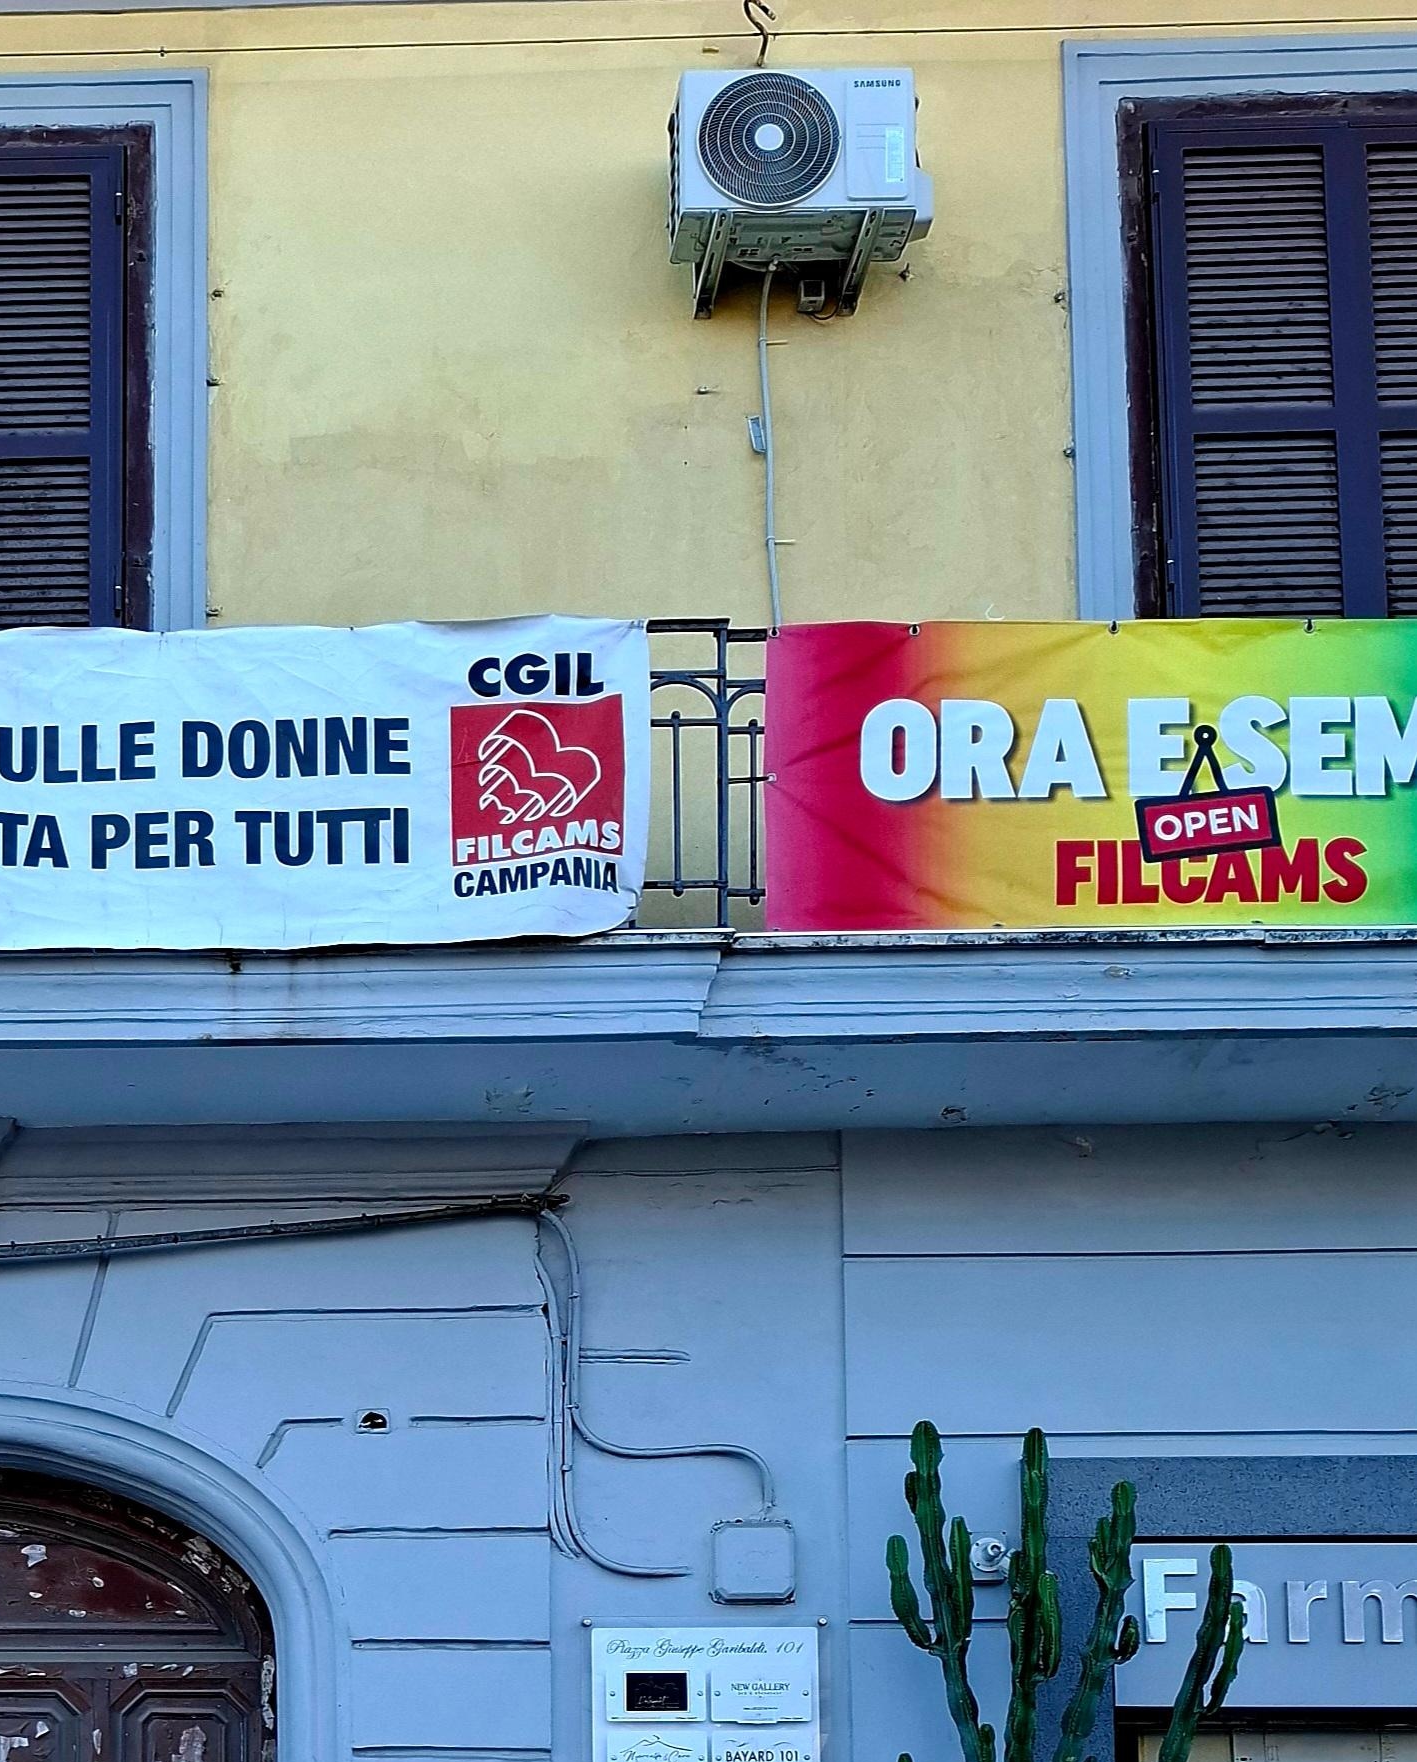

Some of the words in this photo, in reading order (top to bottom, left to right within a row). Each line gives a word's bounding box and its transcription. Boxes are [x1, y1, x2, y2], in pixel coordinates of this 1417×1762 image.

[853, 79, 902, 88] SAMSUNG
[467, 651, 605, 698] CGIL
[181, 716, 412, 780] DONNE
[859, 697, 1108, 802] ORA
[1128, 696, 1191, 798] E
[90, 809, 216, 870] PER
[234, 807, 411, 867] TUTTI
[456, 818, 621, 863] FILCAMS
[1153, 803, 1260, 843] OPEN
[452, 854, 619, 898] CAMPANIA
[1054, 836, 1369, 908] FILCAMS
[606, 1639, 651, 1660] Piazza
[653, 1638, 705, 1659] Giuseppe
[775, 1641, 804, 1654] 101
[730, 1683, 751, 1691] NEW
[751, 1683, 791, 1691] GALLERY
[725, 1750, 775, 1762] BAYARD
[779, 1750, 799, 1762] 101
